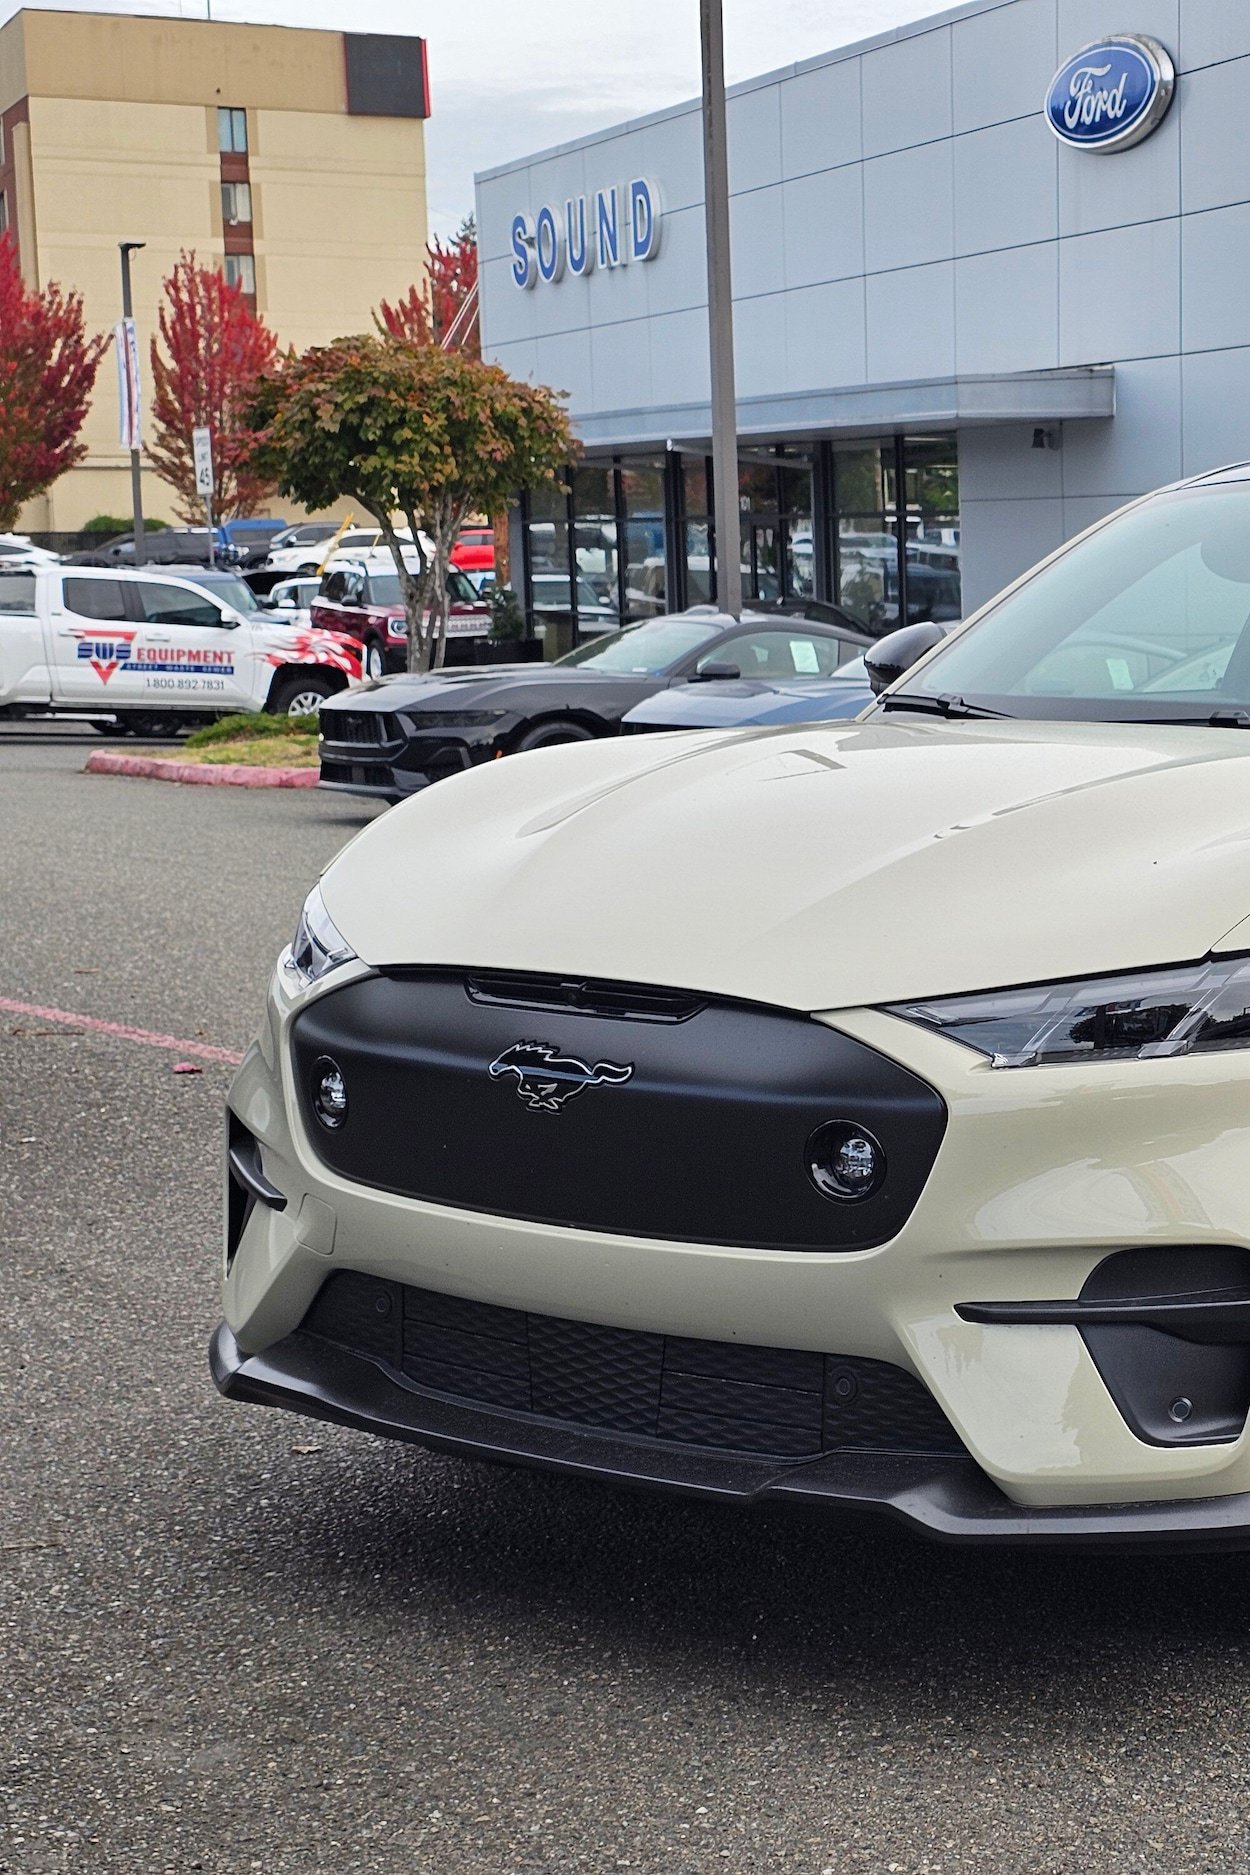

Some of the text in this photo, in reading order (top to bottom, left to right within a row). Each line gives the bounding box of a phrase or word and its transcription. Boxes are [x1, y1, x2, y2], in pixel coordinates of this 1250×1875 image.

[1063, 63, 1128, 129] Ford
[511, 177, 657, 289] SOUND
[77, 642, 132, 660] SWS
[136, 647, 235, 664] EQUIPMENT
